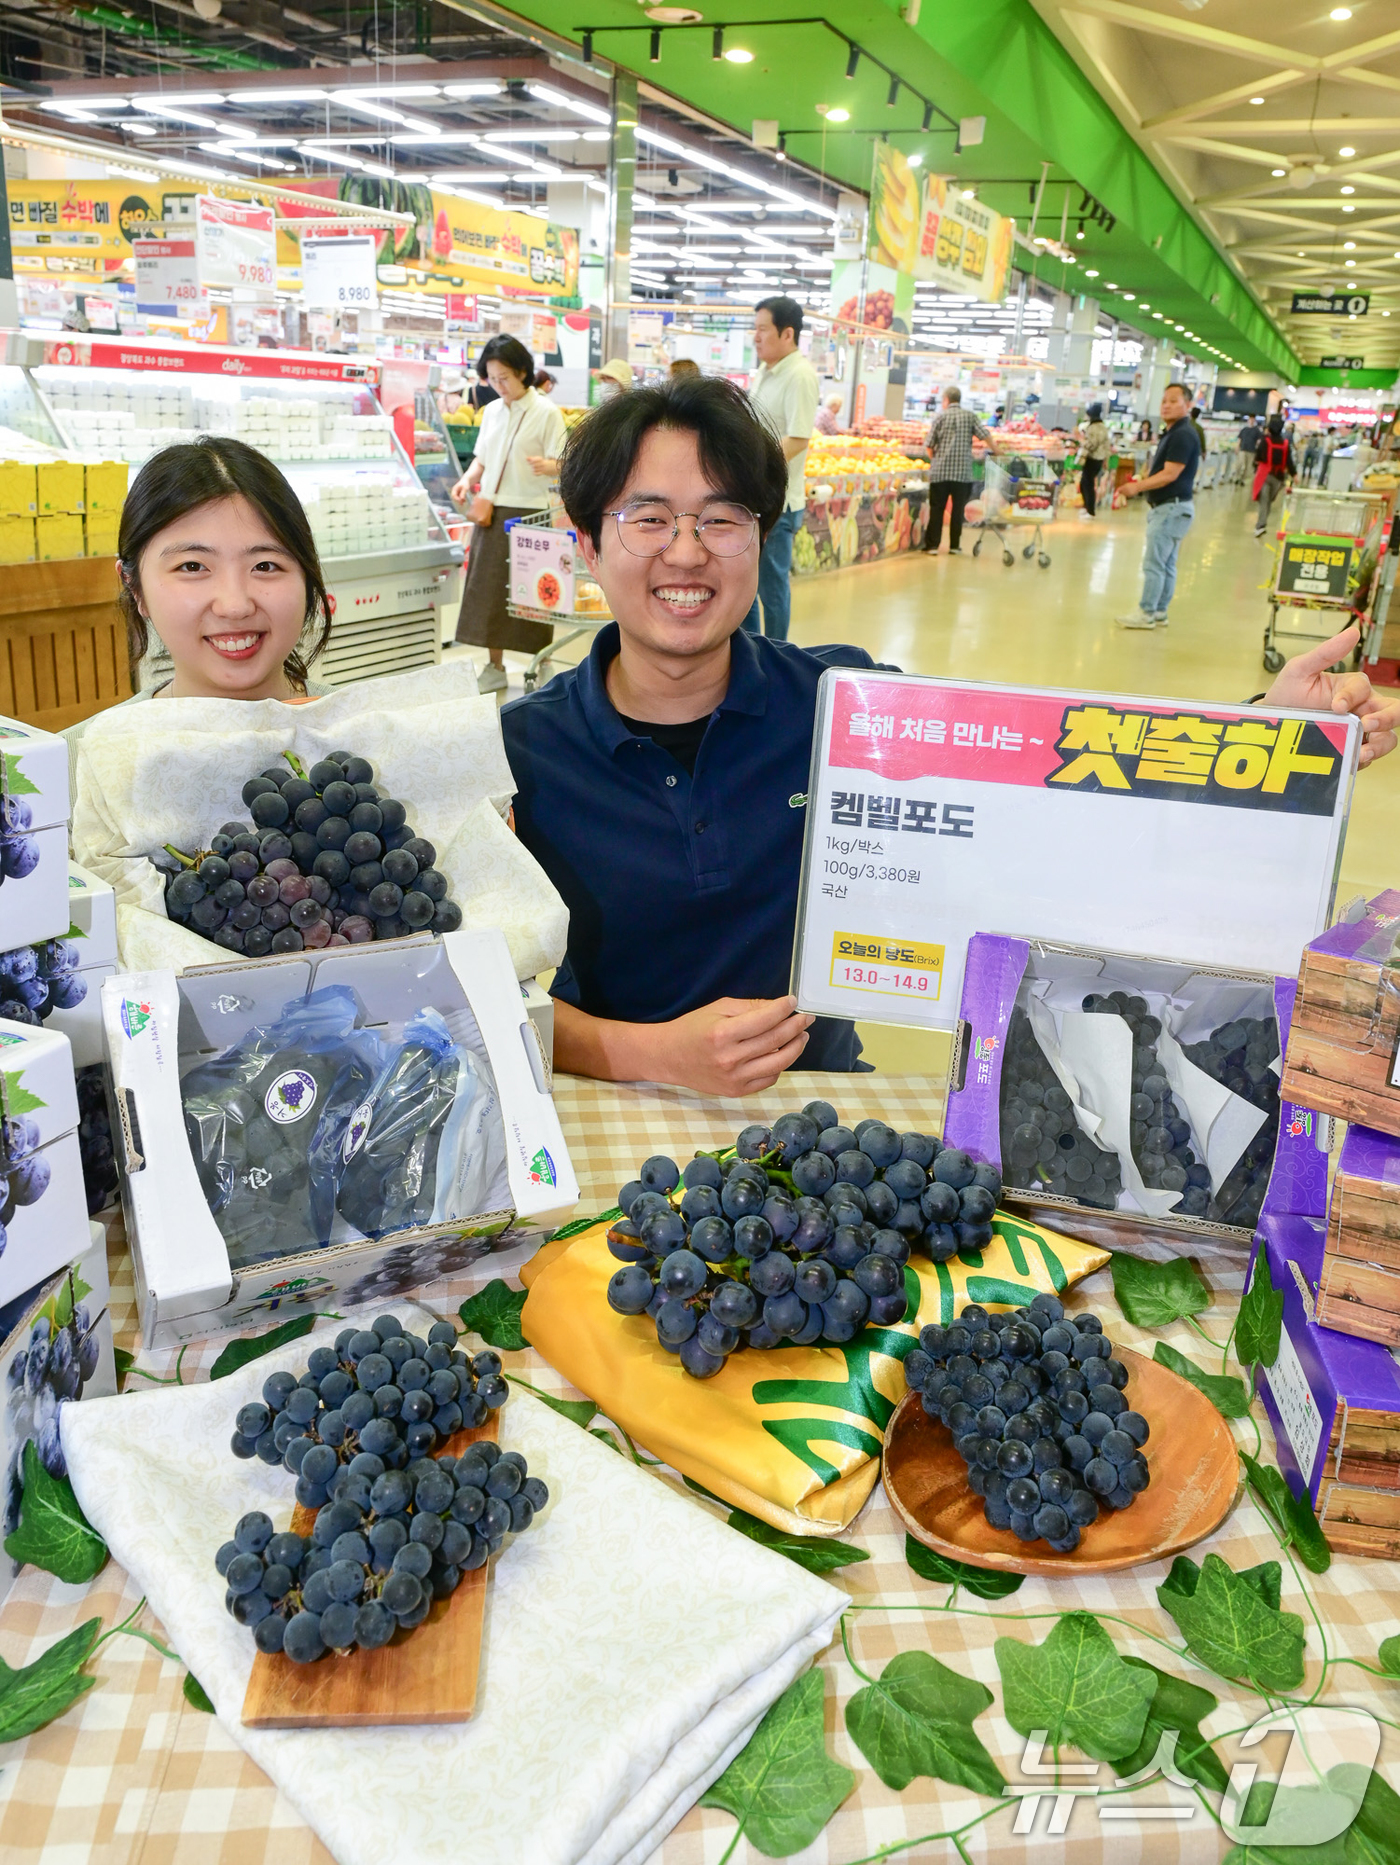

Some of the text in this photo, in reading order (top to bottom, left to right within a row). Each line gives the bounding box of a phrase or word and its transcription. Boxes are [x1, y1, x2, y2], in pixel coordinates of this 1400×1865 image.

[29, 202, 57, 223] 빠질
[61, 199, 110, 224] 수박에
[239, 264, 272, 283] 9,980
[166, 286, 197, 300] 7,480
[339, 287, 370, 301] 8,980
[221, 358, 245, 374] daily
[517, 536, 550, 552] 강화 순무
[1289, 547, 1346, 566] 매장작업
[1300, 563, 1329, 579] 전용
[849, 712, 894, 739] 올해
[899, 717, 947, 744] 처음
[953, 722, 1023, 751] 만나는
[1048, 705, 1336, 794] 첫출하
[831, 791, 974, 838] 켐벨포도
[826, 836, 884, 856] 1kg/박스
[823, 860, 921, 884] 100g/3,380원
[821, 883, 848, 899] 국산
[838, 940, 881, 958] 오늘의
[844, 967, 928, 991] 13.0~14.9
[977, 1062, 989, 1084] 포도
